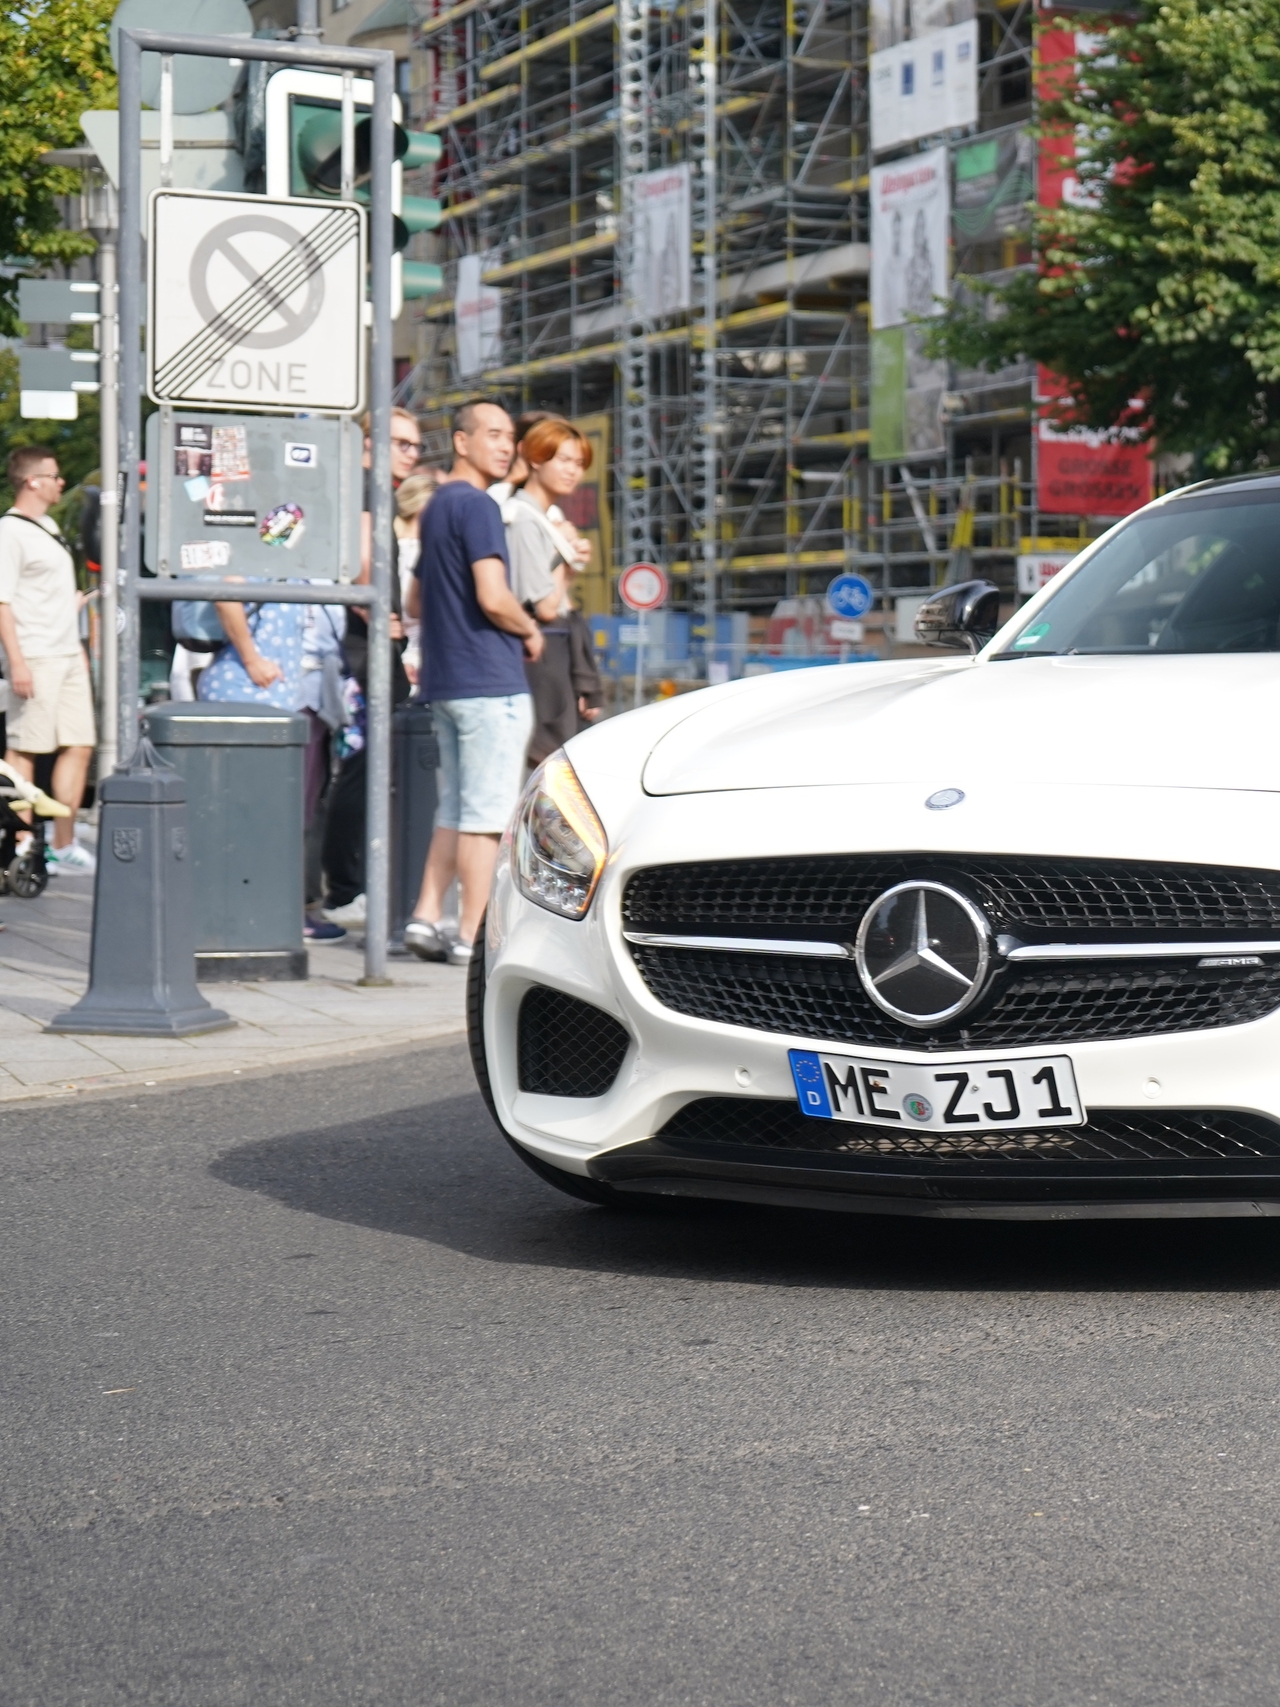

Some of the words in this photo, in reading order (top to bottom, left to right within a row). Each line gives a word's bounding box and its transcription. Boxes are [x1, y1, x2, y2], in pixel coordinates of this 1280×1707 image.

[206, 357, 307, 393] ZONE
[806, 1090, 821, 1106] D
[824, 1061, 902, 1120] ME
